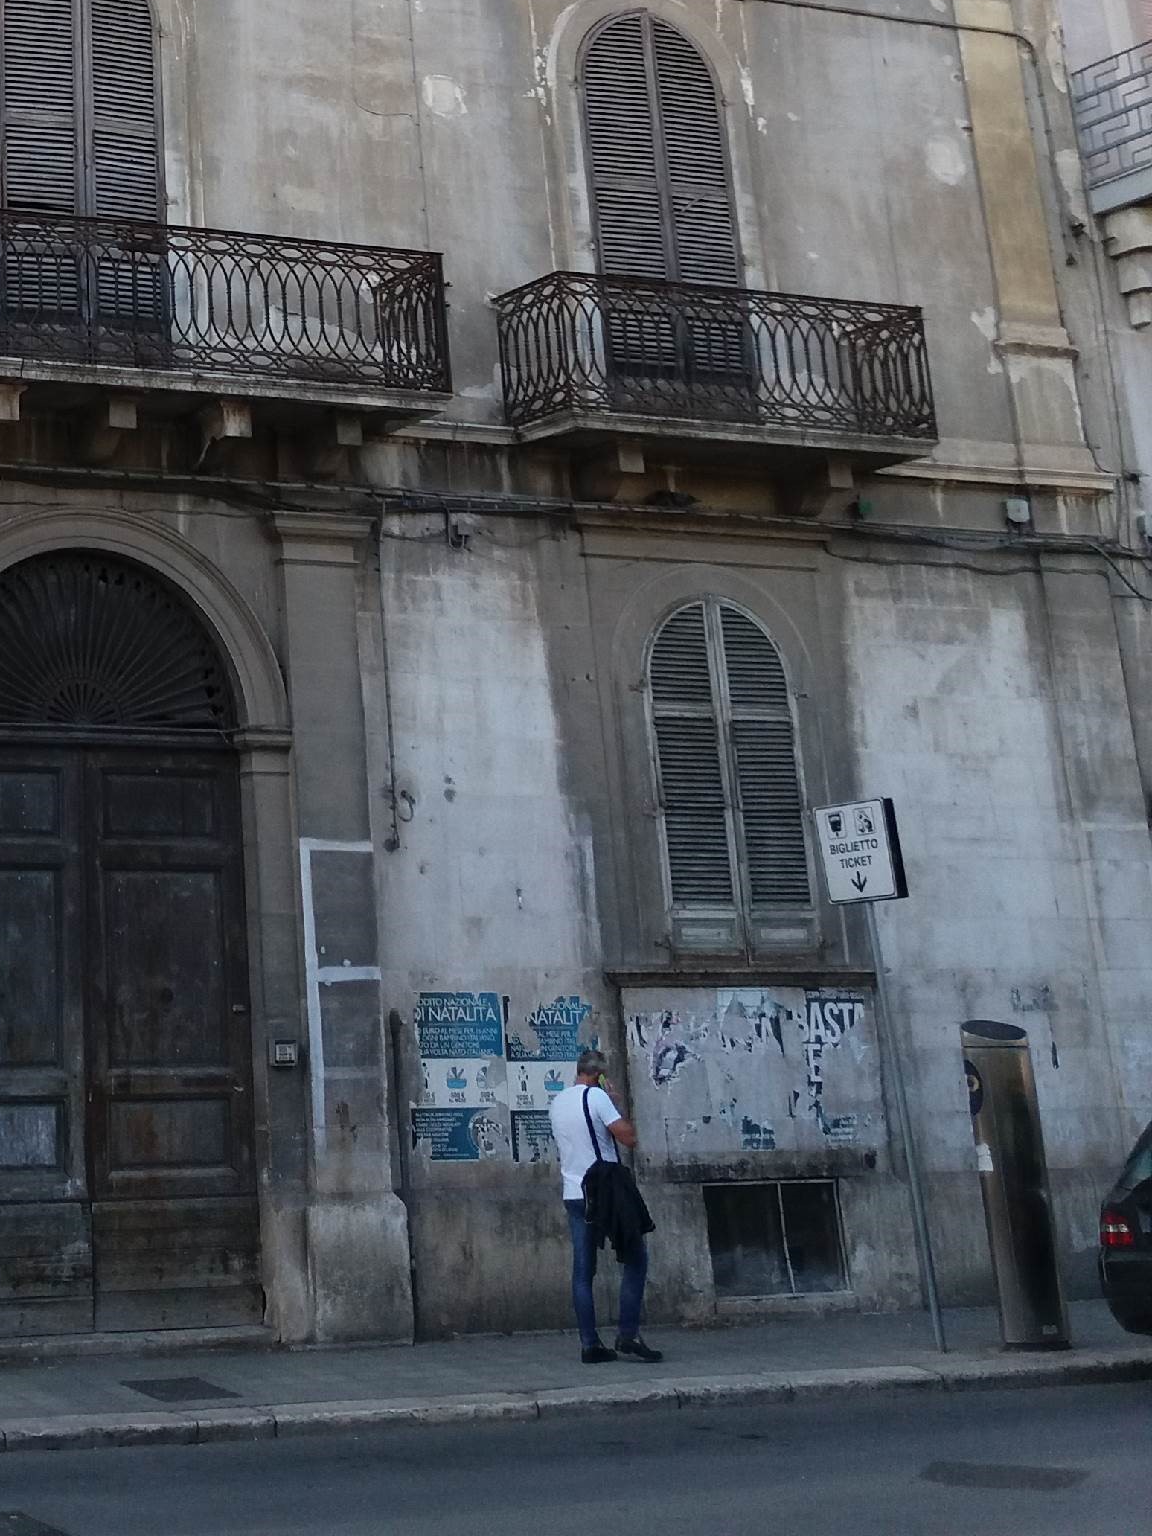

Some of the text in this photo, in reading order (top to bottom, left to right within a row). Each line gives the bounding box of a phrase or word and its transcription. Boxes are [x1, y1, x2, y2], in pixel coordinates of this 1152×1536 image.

[829, 838, 879, 855] BIGLIETTO
[839, 855, 872, 869] TICKET
[419, 998, 442, 1006] DDITO
